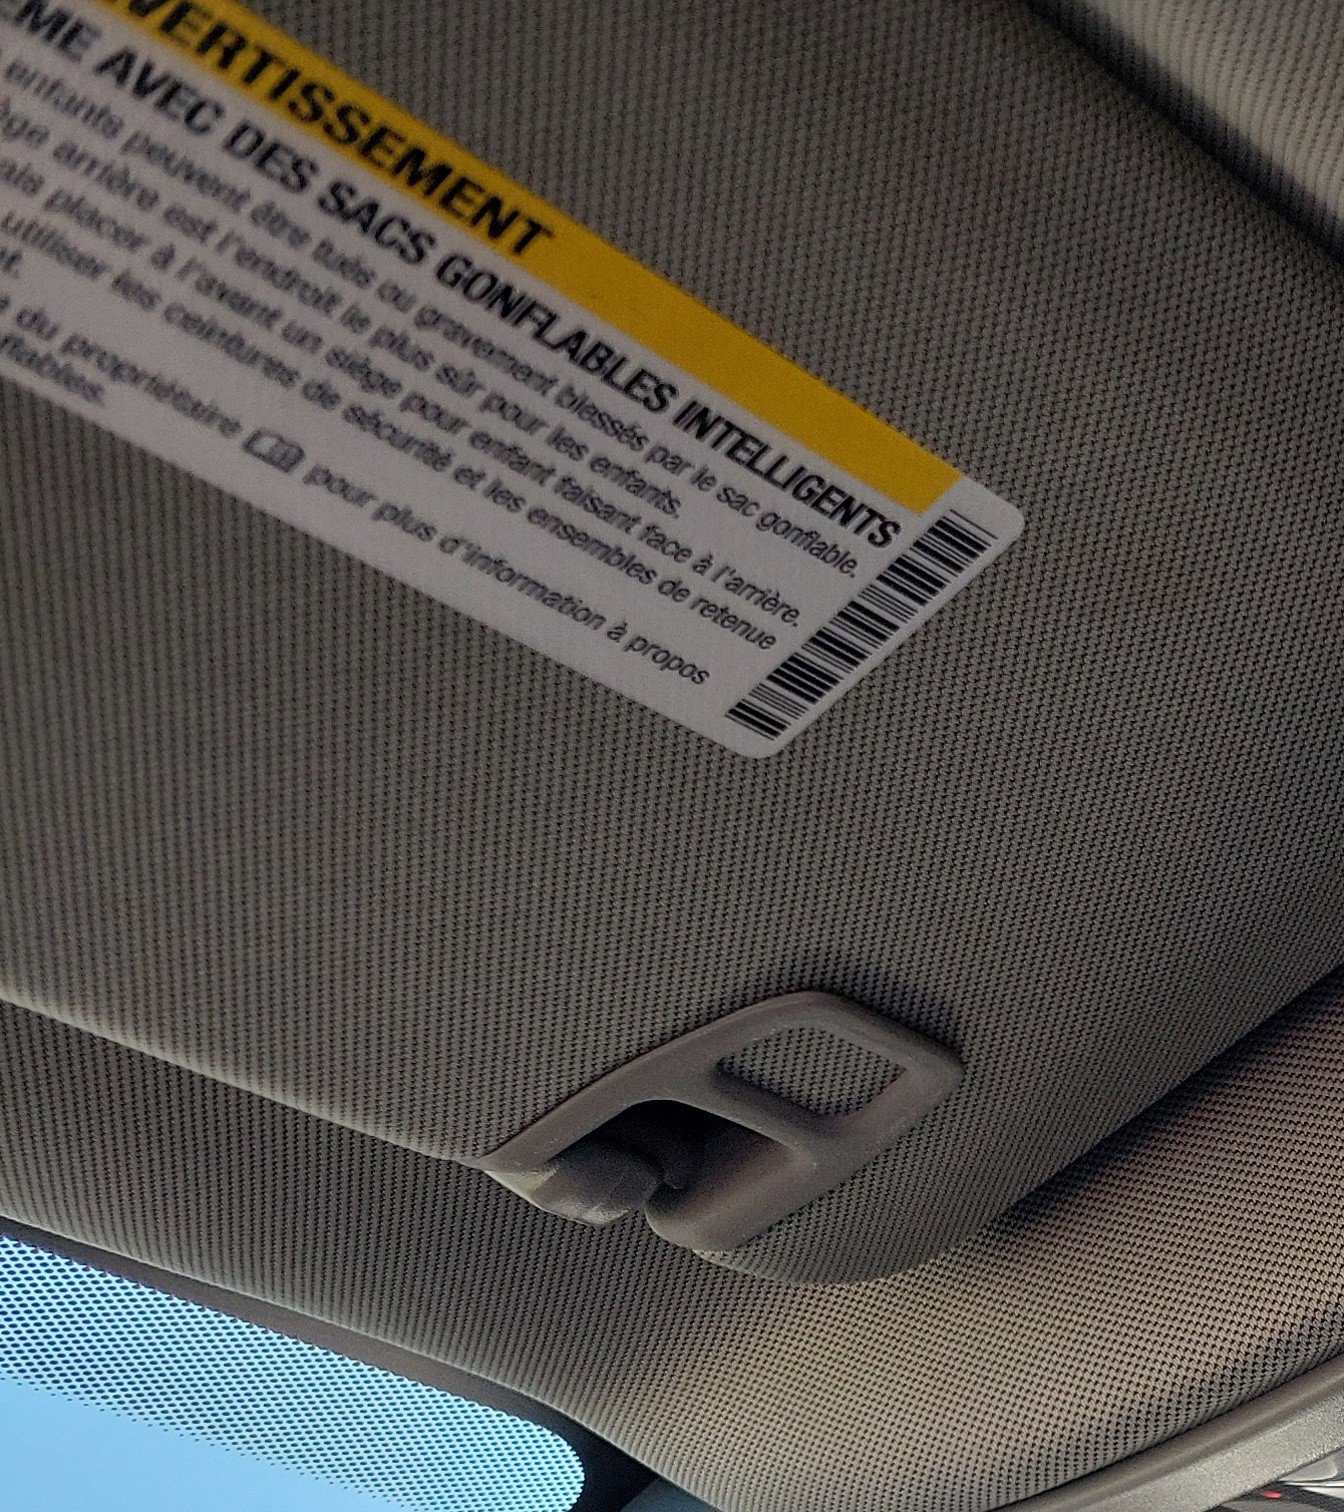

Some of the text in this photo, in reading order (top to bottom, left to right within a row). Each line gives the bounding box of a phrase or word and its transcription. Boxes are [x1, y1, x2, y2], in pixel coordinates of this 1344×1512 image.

[0, 0, 903, 550] ME AVEC DES SACS GONFLABLES INTELLIGENTS
[120, 130, 252, 214] peuvent
[376, 279, 417, 314] ou
[412, 304, 558, 397] gravement
[553, 380, 650, 452] blessés
[643, 442, 699, 483] par
[694, 463, 718, 493] le
[715, 485, 761, 520] sac
[756, 508, 860, 580] gonflable.
[162, 203, 218, 245] est
[339, 304, 372, 336] le
[367, 324, 436, 372] plus
[435, 362, 486, 398] sûr
[477, 390, 550, 437] pour
[545, 422, 591, 463] les
[587, 451, 682, 520] enfants.
[59, 332, 242, 440] propriétaire
[302, 463, 379, 508] pour
[371, 502, 438, 543] plus
[437, 533, 605, 632] d'information
[606, 619, 629, 643] à
[624, 634, 711, 687] propos
[110, 268, 163, 313] les
[162, 302, 300, 389] ceintures
[301, 377, 342, 411] de
[341, 404, 457, 473] sécurité
[451, 462, 488, 491] et
[482, 477, 527, 514] les
[525, 505, 656, 588] ensembles
[655, 577, 692, 606] de
[689, 594, 779, 653] retenue
[280, 319, 324, 355] un
[399, 391, 471, 436] pour
[468, 429, 557, 488] enfant
[551, 467, 645, 537] faisant
[637, 516, 694, 564] face
[691, 551, 716, 577] à
[711, 564, 801, 629] l'arrière.
